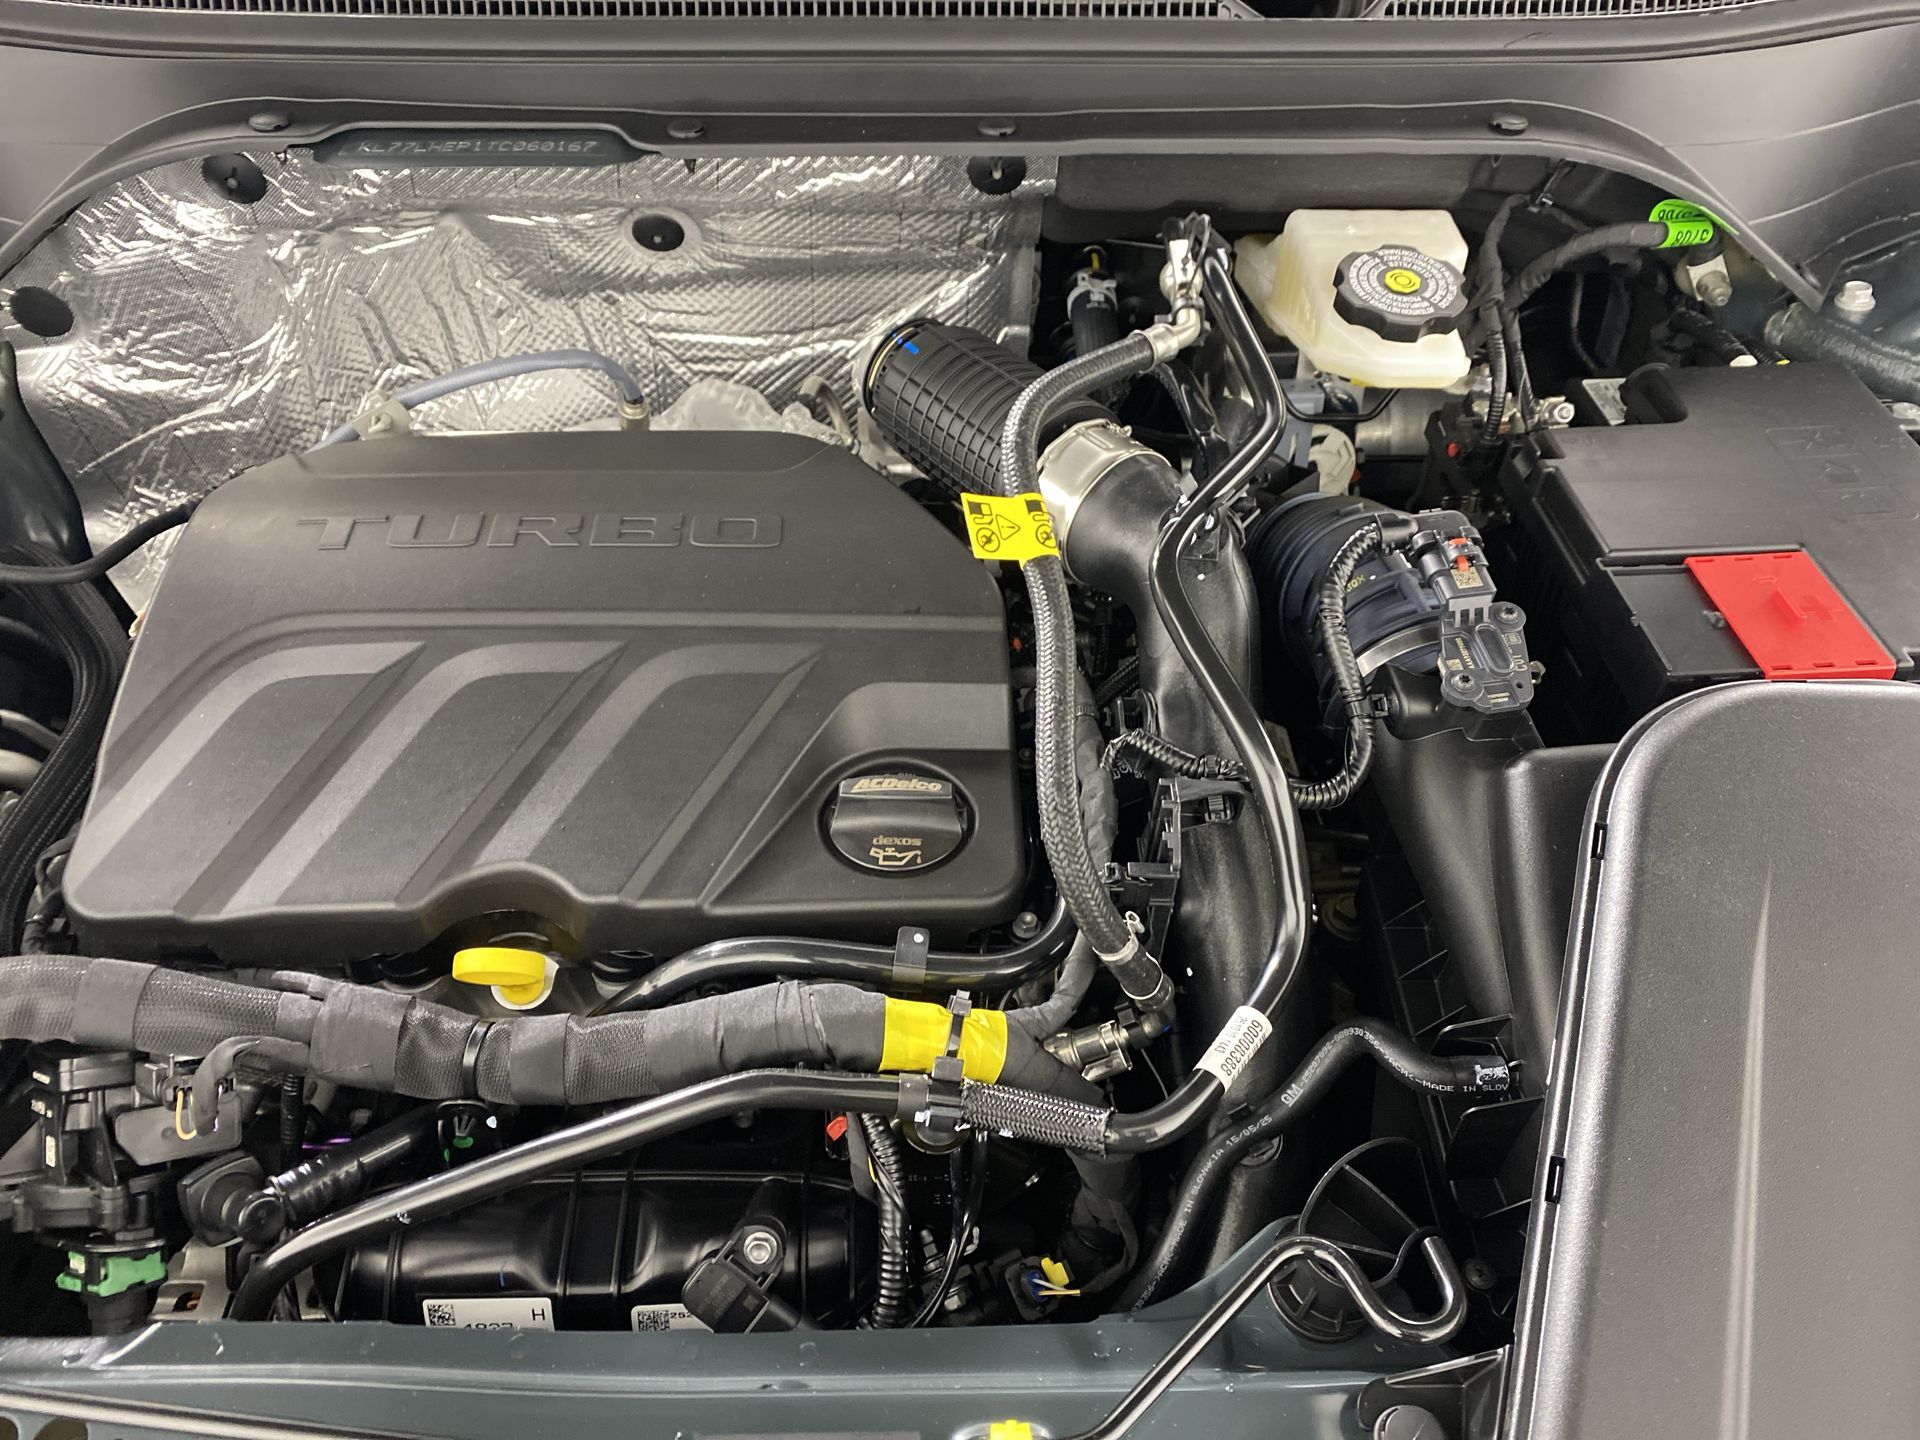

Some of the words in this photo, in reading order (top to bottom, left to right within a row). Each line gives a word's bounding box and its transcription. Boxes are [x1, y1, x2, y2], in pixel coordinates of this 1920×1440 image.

[357, 140, 598, 153] KL77LHEP1TC060167
[298, 511, 784, 551] TURBO
[851, 778, 942, 792] ACDelco
[872, 835, 923, 846] dexos
[1220, 1019, 1263, 1076] 60008388
[1191, 1148, 1225, 1196] SLOVAKIA
[531, 1308, 546, 1321] H
